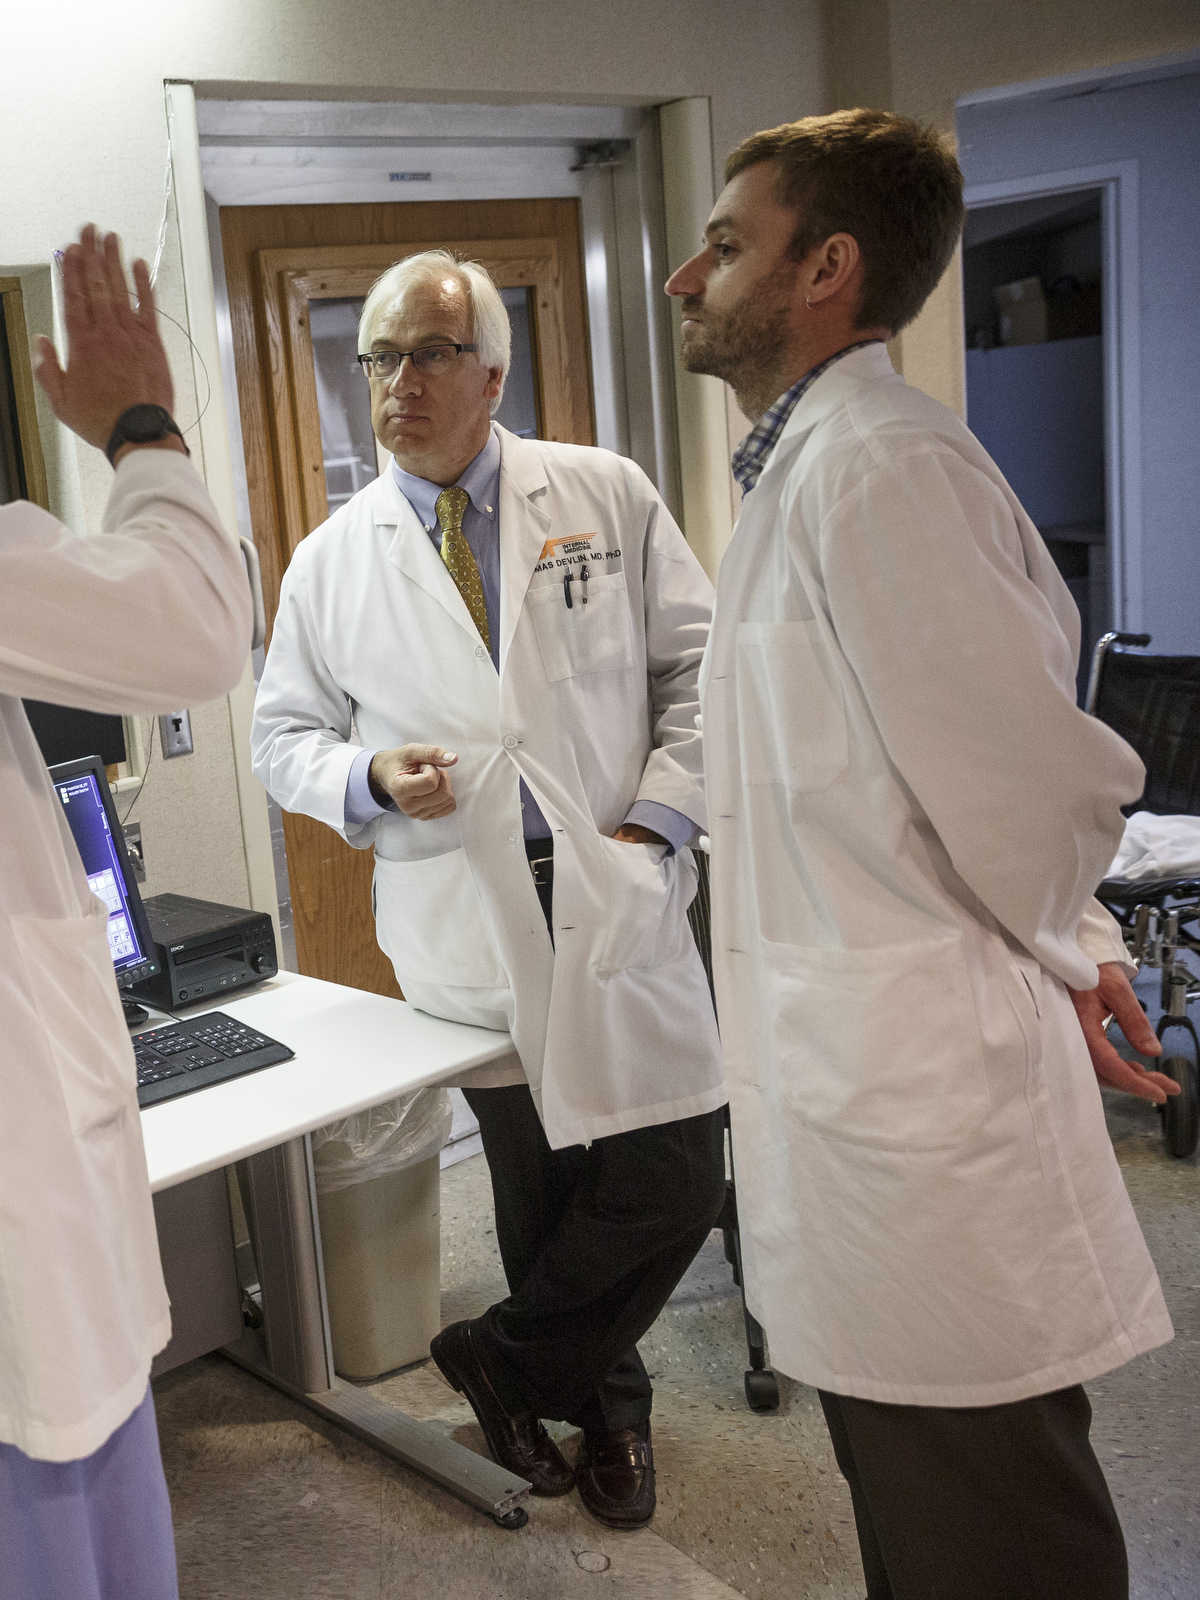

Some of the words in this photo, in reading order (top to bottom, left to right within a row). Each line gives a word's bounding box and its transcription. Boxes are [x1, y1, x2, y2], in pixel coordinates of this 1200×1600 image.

[562, 540, 590, 550] INTERNAL
[564, 545, 592, 554] MEDICINE
[605, 549, 622, 560] PhD
[170, 944, 184, 953] DENON
